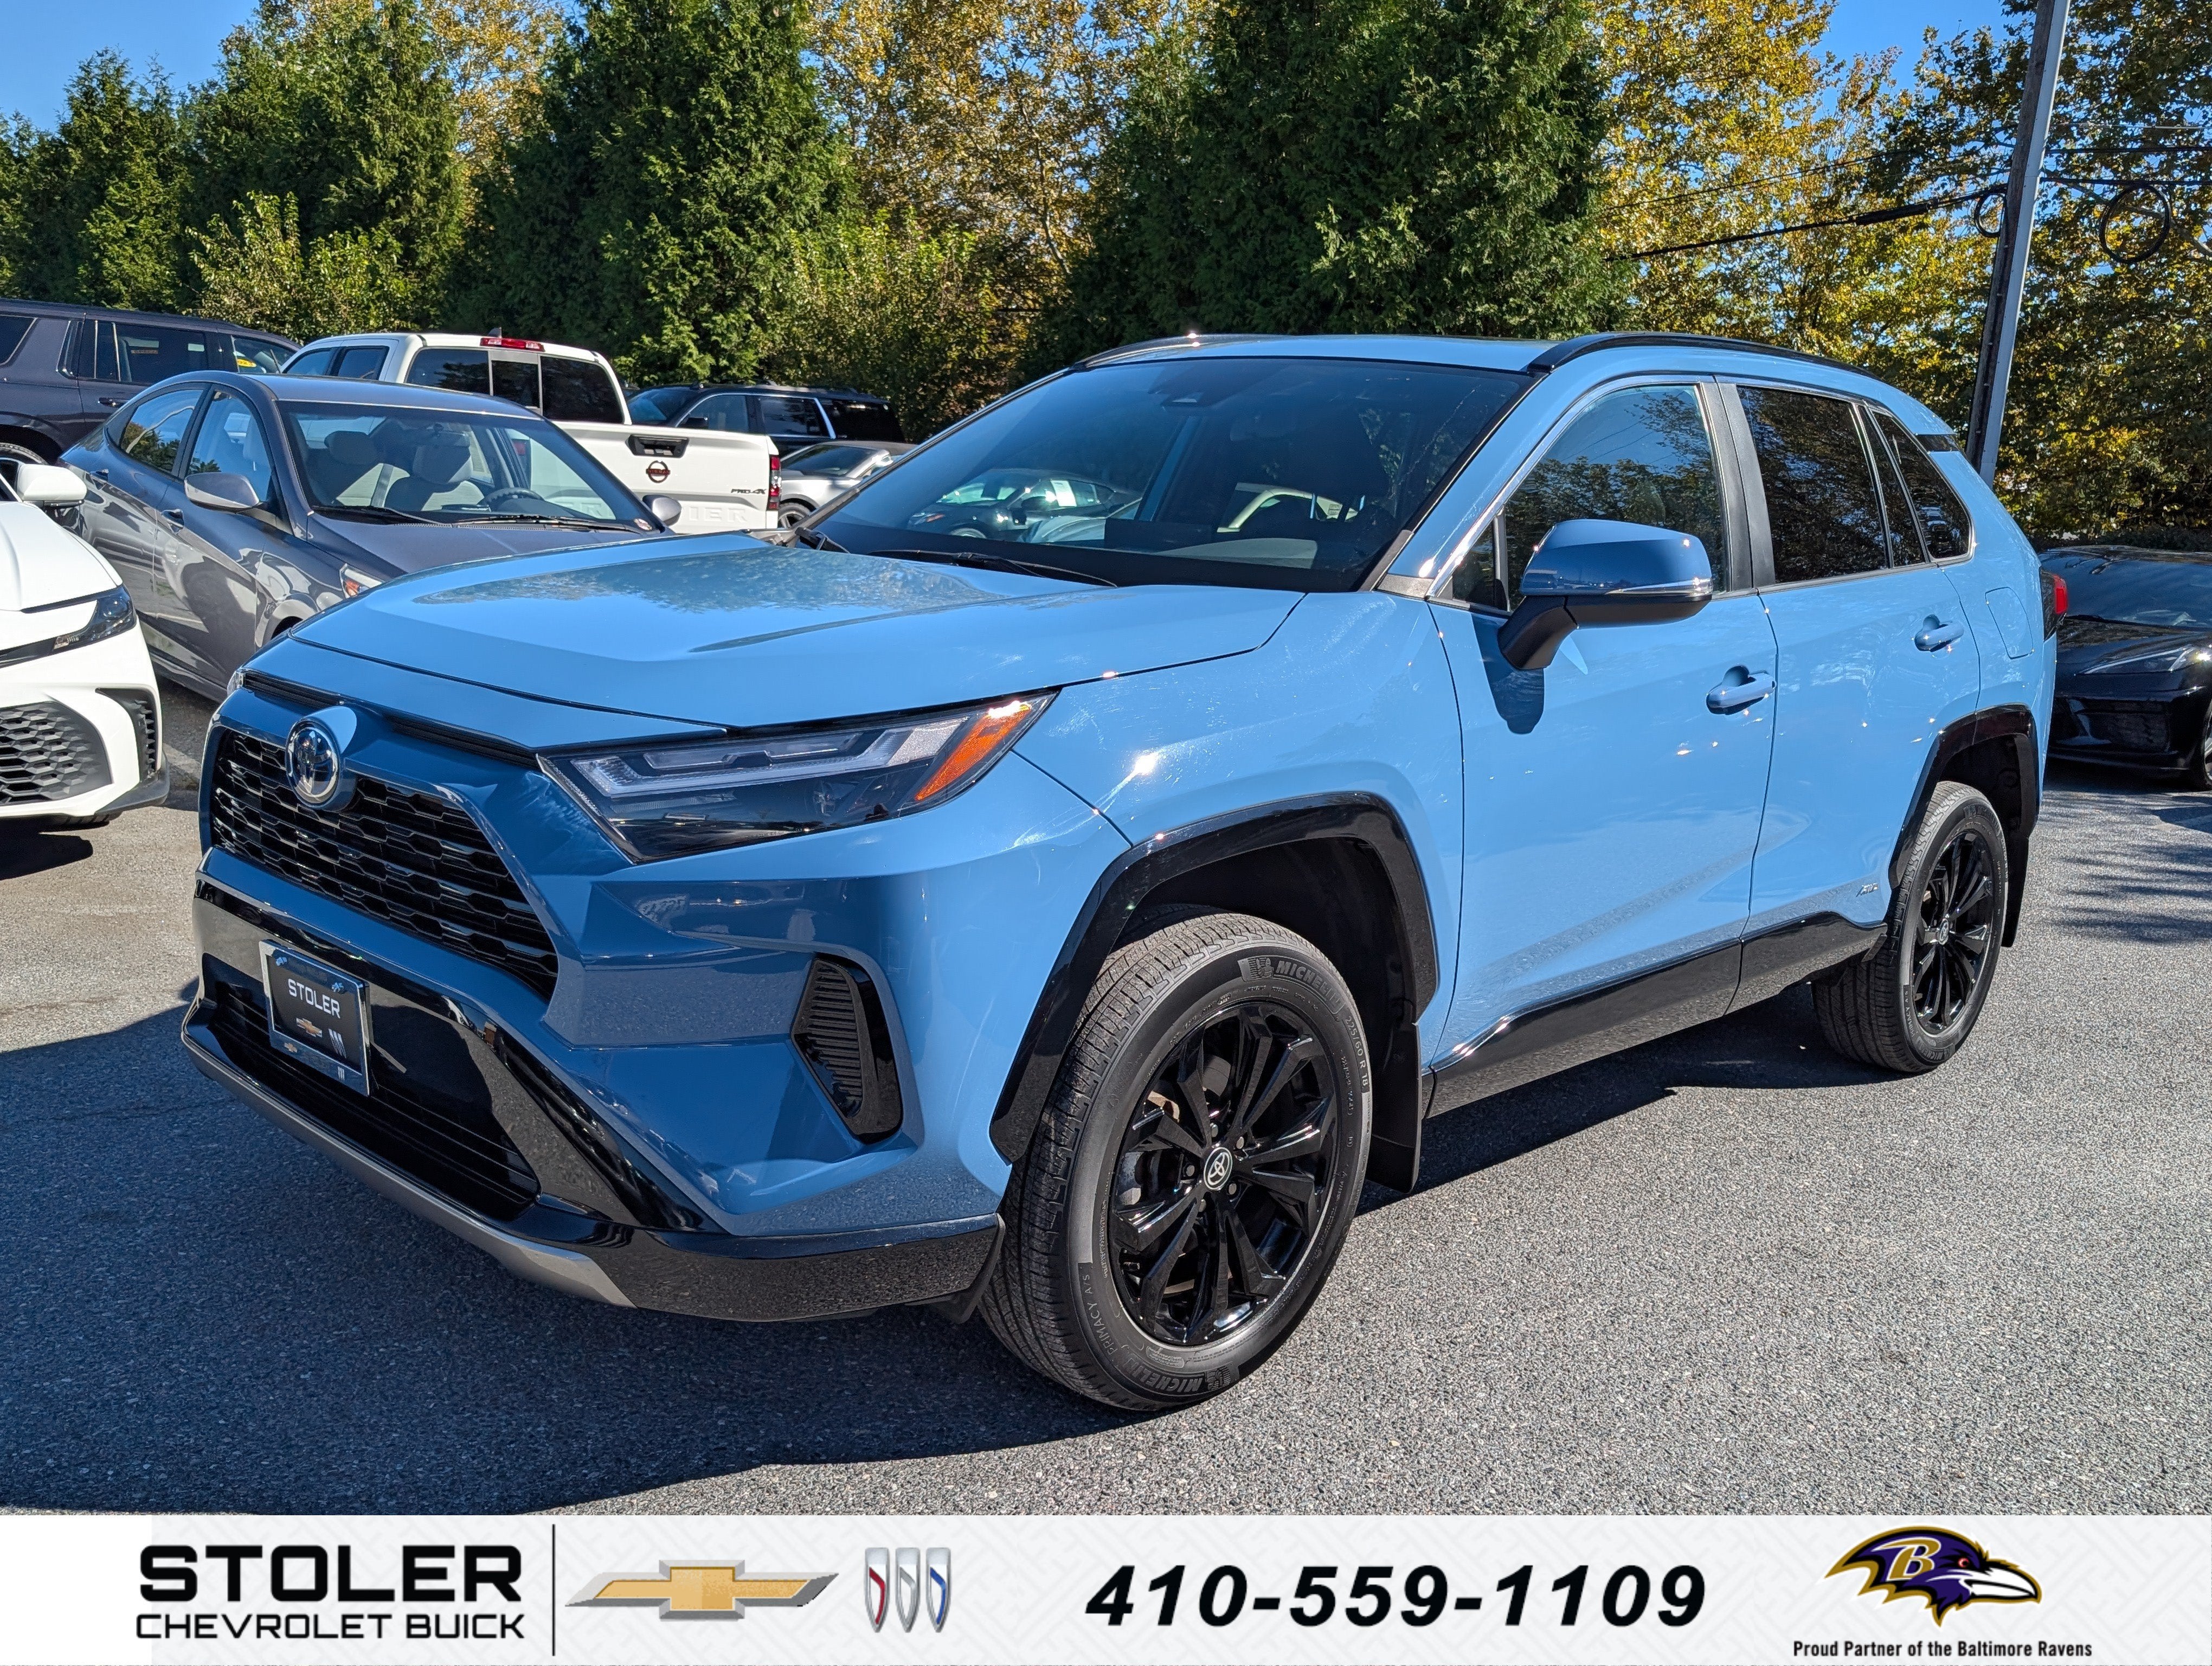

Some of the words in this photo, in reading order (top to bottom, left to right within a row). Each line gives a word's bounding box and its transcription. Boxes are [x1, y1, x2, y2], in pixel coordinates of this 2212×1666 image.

[288, 978, 341, 1019] STOLER
[1345, 1016, 1364, 1056] 225/60
[1359, 1060, 1366, 1069] R
[1361, 1073, 1368, 1086] 18
[1082, 1274, 1093, 1295] A/S
[1086, 1302, 1118, 1356] PRIMACY
